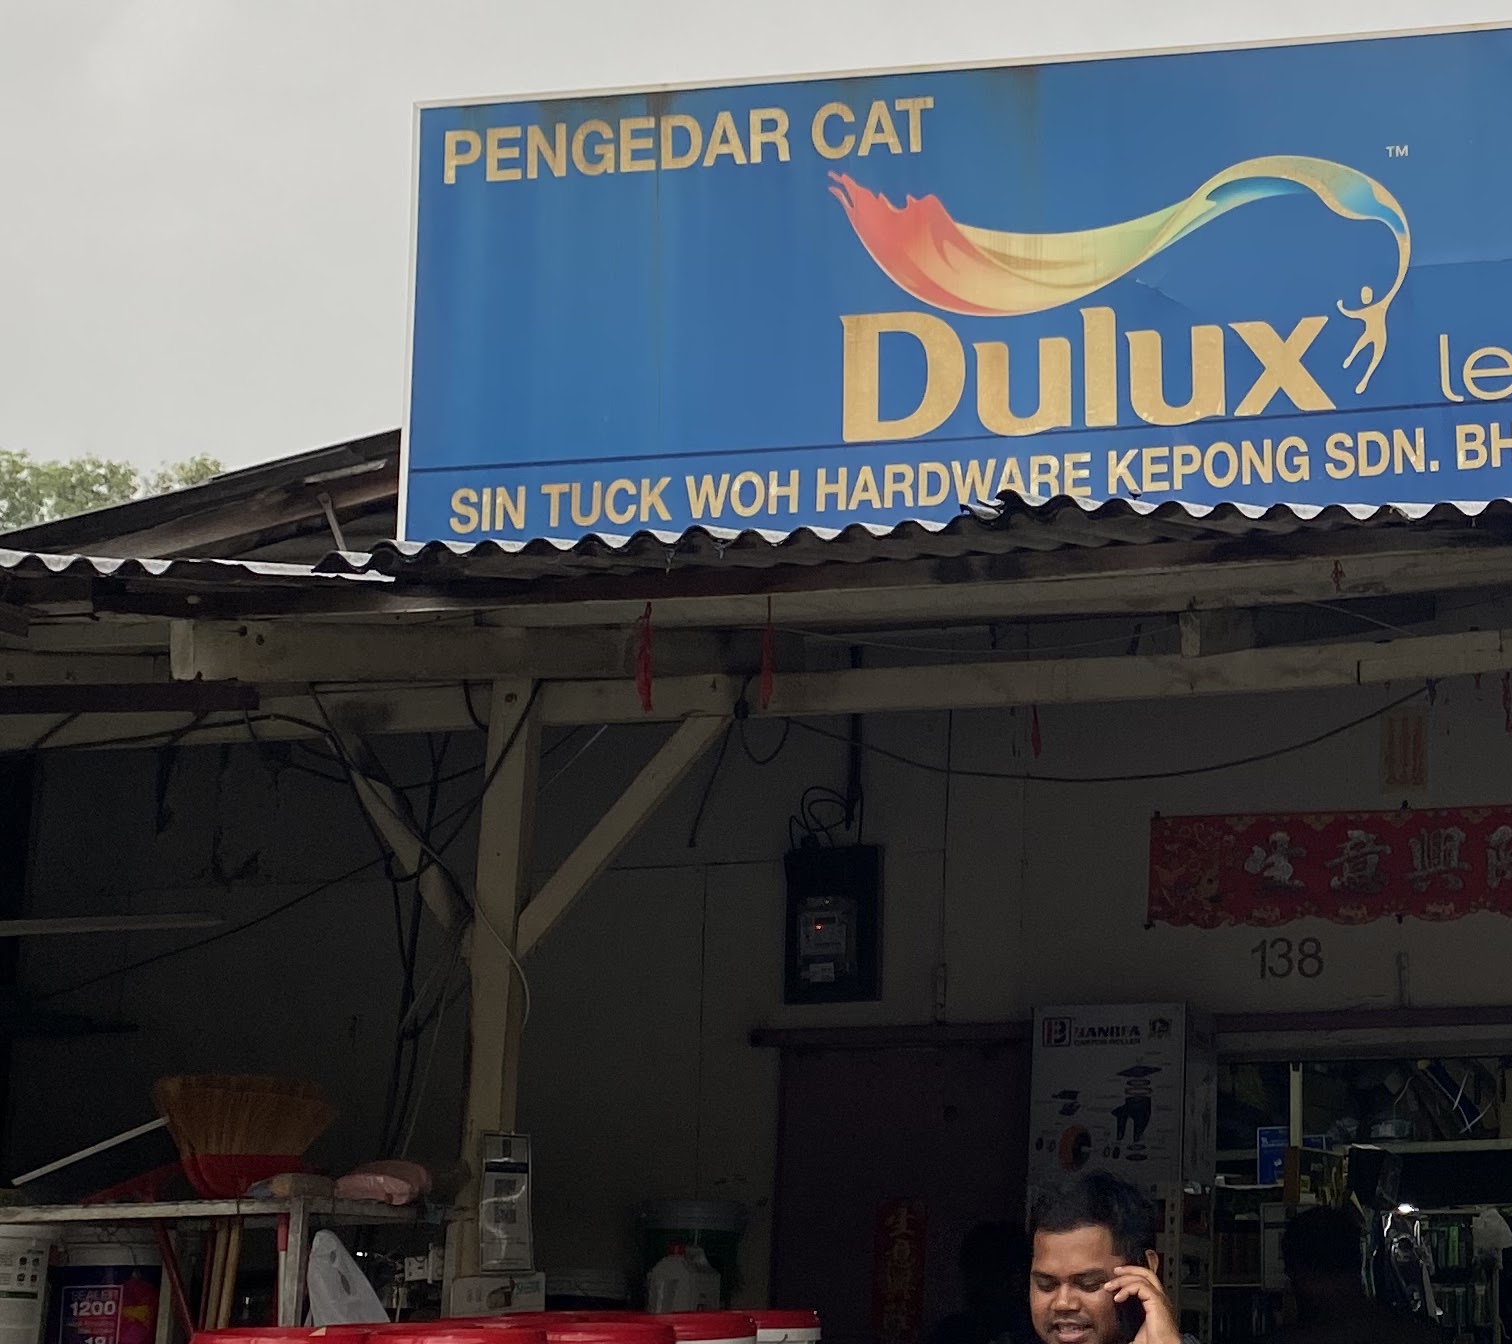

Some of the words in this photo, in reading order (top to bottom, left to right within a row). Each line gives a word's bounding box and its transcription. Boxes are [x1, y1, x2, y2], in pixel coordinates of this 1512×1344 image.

[442, 107, 791, 185] PENGEDAR
[811, 96, 936, 160] CAT
[839, 306, 1336, 443] Dulux
[450, 485, 527, 534] SIN
[541, 476, 673, 529] TUCK
[686, 469, 801, 520] WOH
[815, 451, 1092, 512] HARDWARE
[1107, 436, 1310, 496] KEPONG
[1324, 426, 1438, 481] SDN.
[1250, 937, 1325, 980] 138
[69, 1300, 116, 1317] 1200
